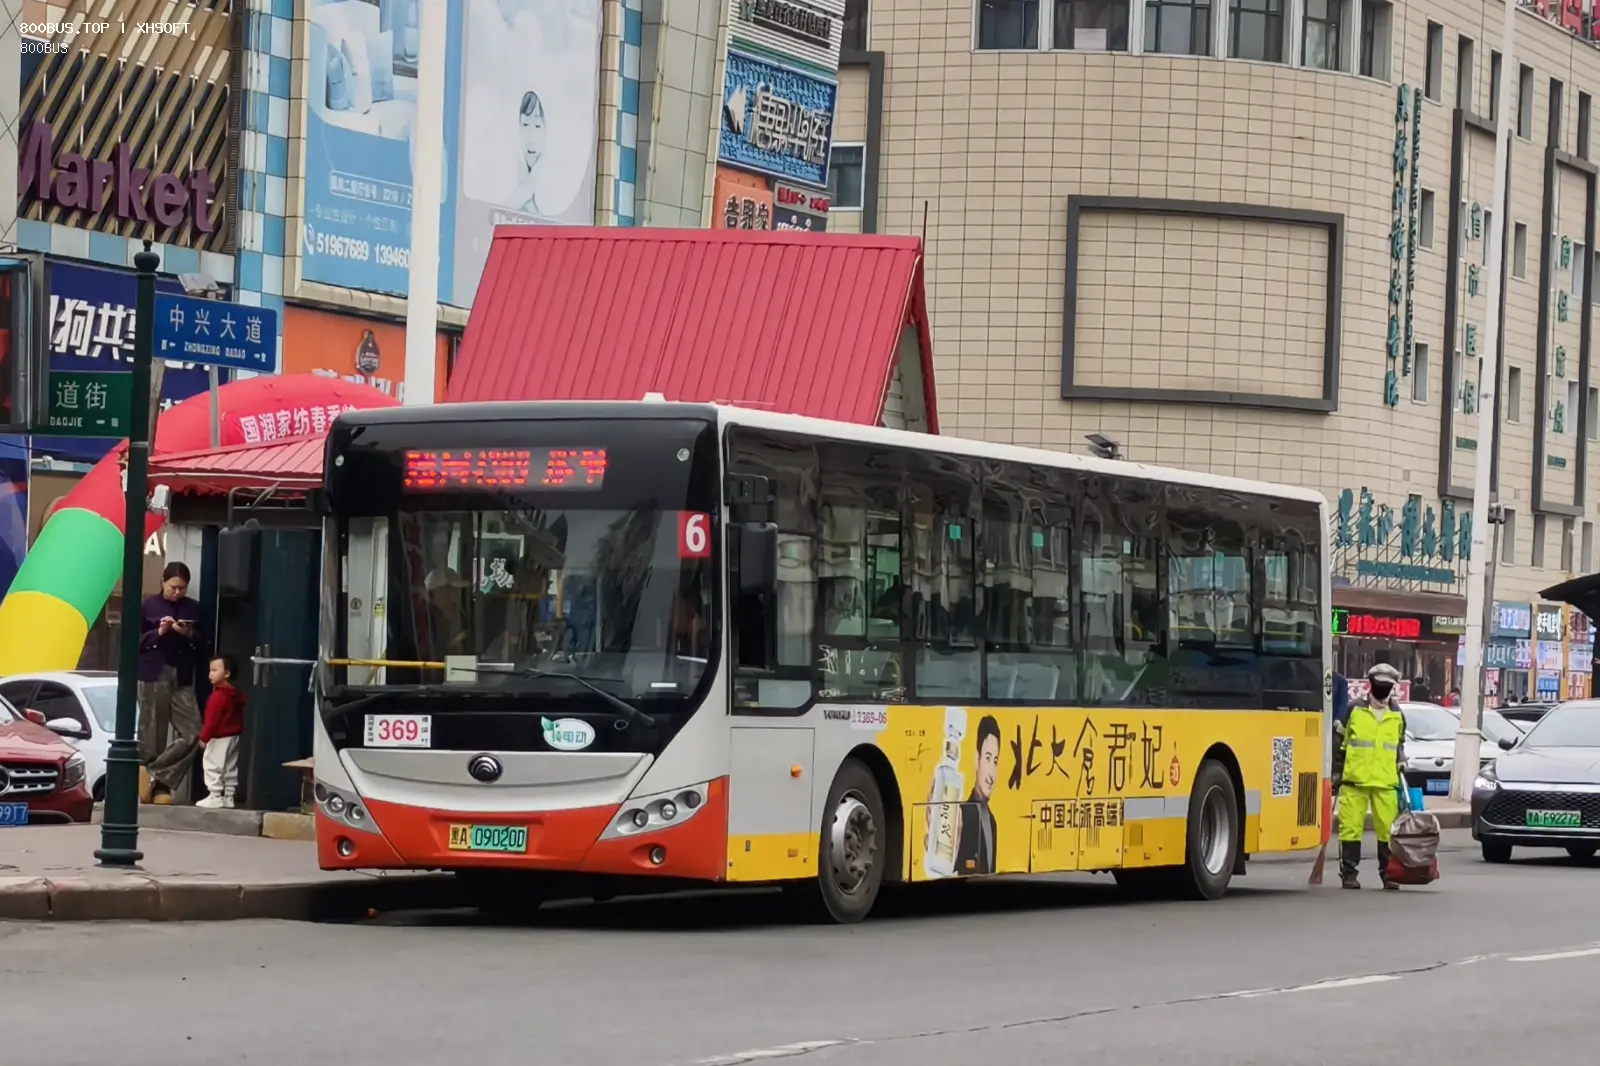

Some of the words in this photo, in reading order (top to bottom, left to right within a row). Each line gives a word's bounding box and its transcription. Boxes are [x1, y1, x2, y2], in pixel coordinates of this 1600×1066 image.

[18, 122, 215, 232] Market
[50, 295, 137, 363] 狗共
[169, 303, 263, 344] 中兴大道
[184, 341, 221, 356] ZHONGXING
[225, 347, 246, 360] DADAO
[239, 404, 358, 444] 国润家纺春季
[685, 514, 706, 552] 6
[378, 719, 418, 741] 369
[1040, 802, 1125, 829] 中国北派高端
